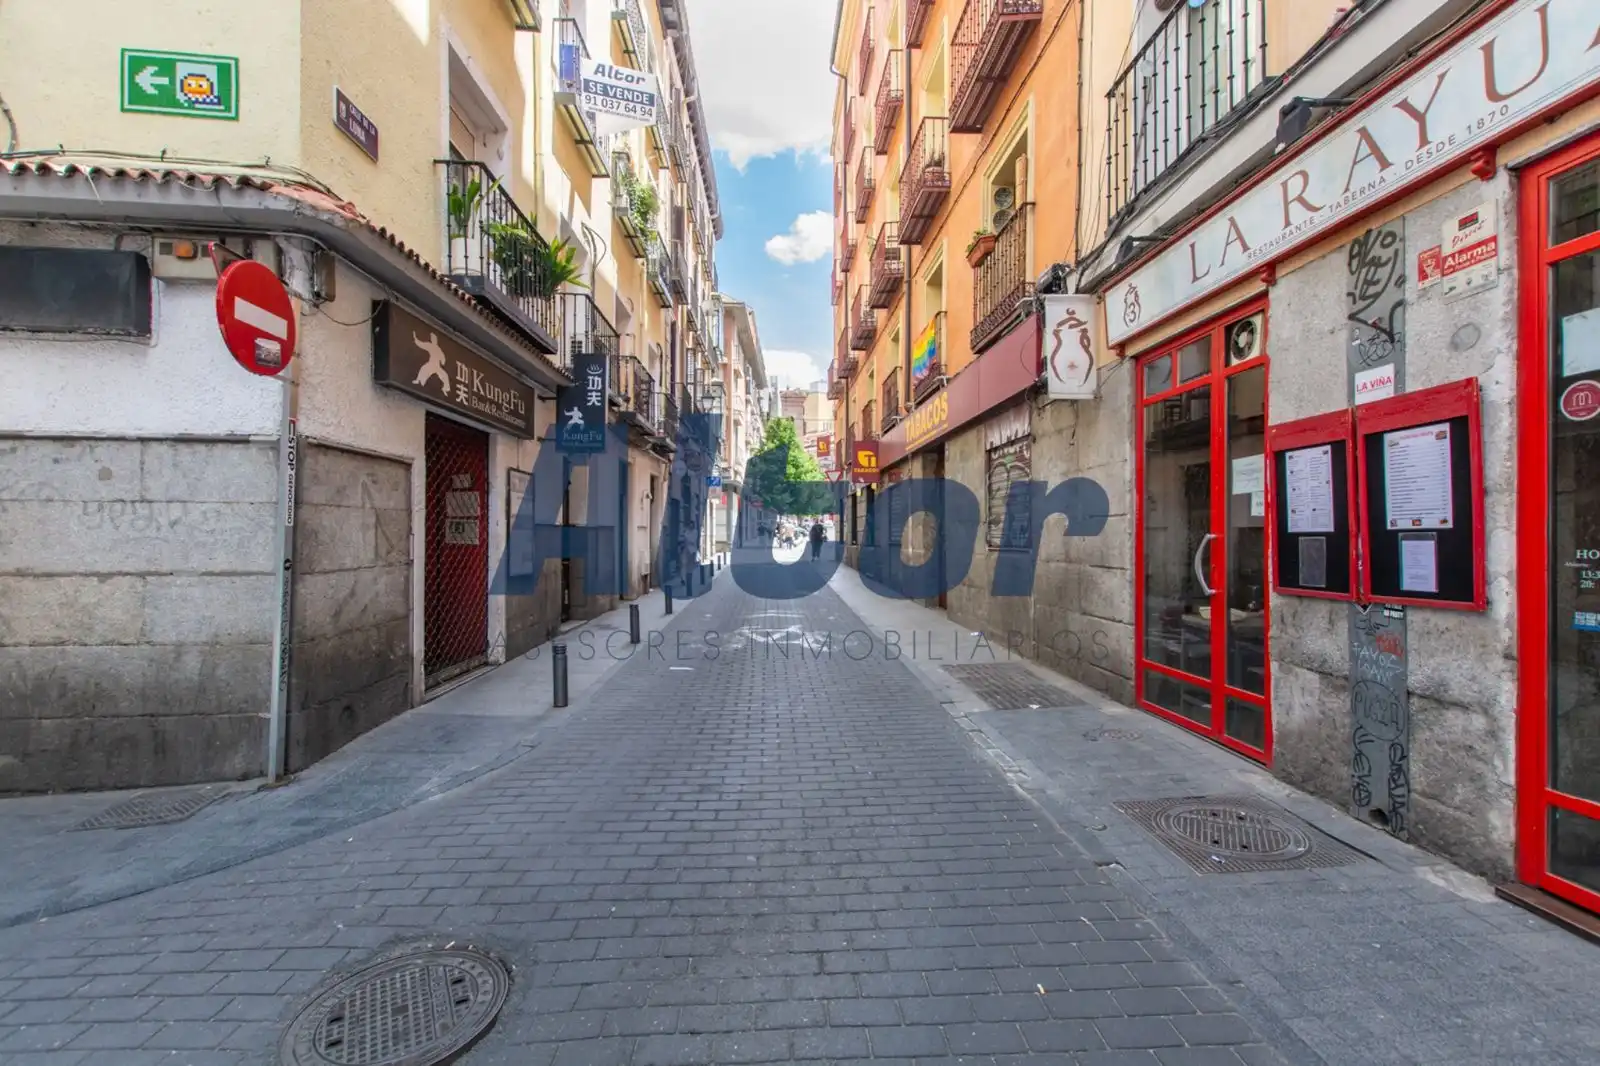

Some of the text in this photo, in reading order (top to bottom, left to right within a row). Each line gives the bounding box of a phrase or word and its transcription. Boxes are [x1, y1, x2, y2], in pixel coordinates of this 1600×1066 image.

[588, 81, 650, 104] SE VENDE
[593, 63, 646, 85] Altor
[584, 94, 598, 107] 91
[601, 97, 621, 111] 037
[624, 102, 637, 114] 64
[640, 105, 653, 117] 94
[1189, 216, 1251, 284] LA
[1280, 1, 1600, 231] RAYU
[1247, 104, 1510, 260] RESTAURANTE TABERNA DESDE 1870
[1444, 241, 1496, 268] Alarma
[455, 360, 469, 406] 功夫
[472, 368, 525, 415] KungFu
[586, 375, 602, 406] 功夫
[1356, 382, 1368, 392] LA
[905, 391, 948, 442] TABACOS
[286, 436, 296, 525] STOP GENOCIDIO
